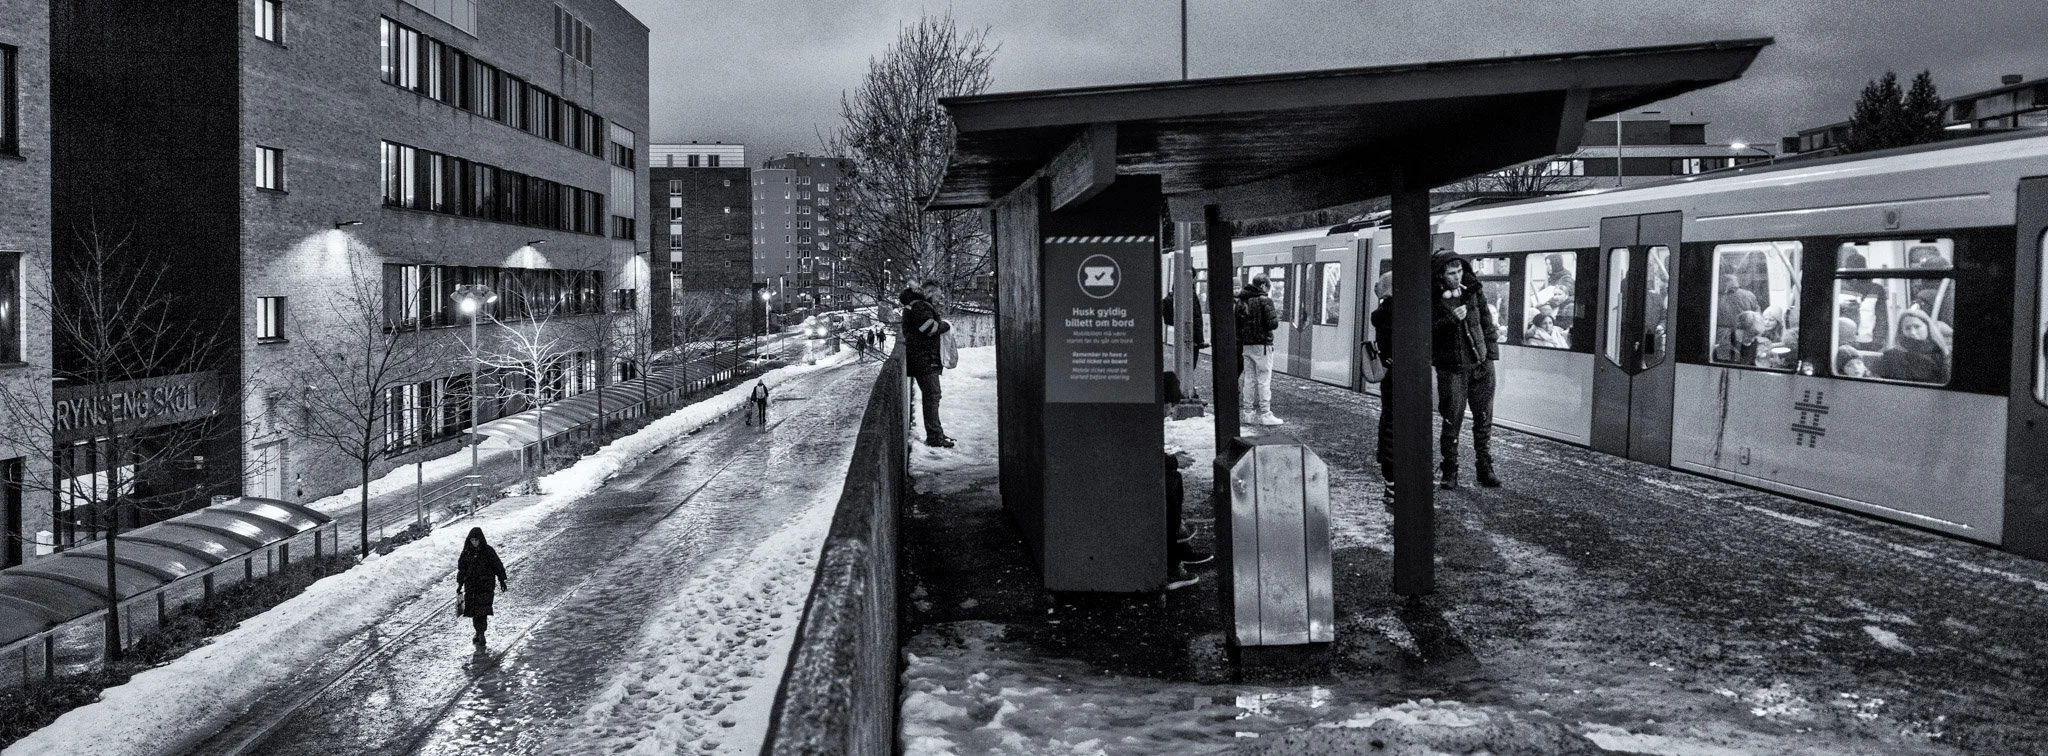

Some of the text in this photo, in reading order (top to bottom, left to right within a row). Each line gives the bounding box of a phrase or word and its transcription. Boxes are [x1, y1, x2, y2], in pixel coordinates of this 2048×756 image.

[1073, 307, 1127, 318] Husk gyldig
[1065, 318, 1092, 327] billett
[1112, 318, 1134, 327] bord
[55, 391, 149, 430] RYNSENG
